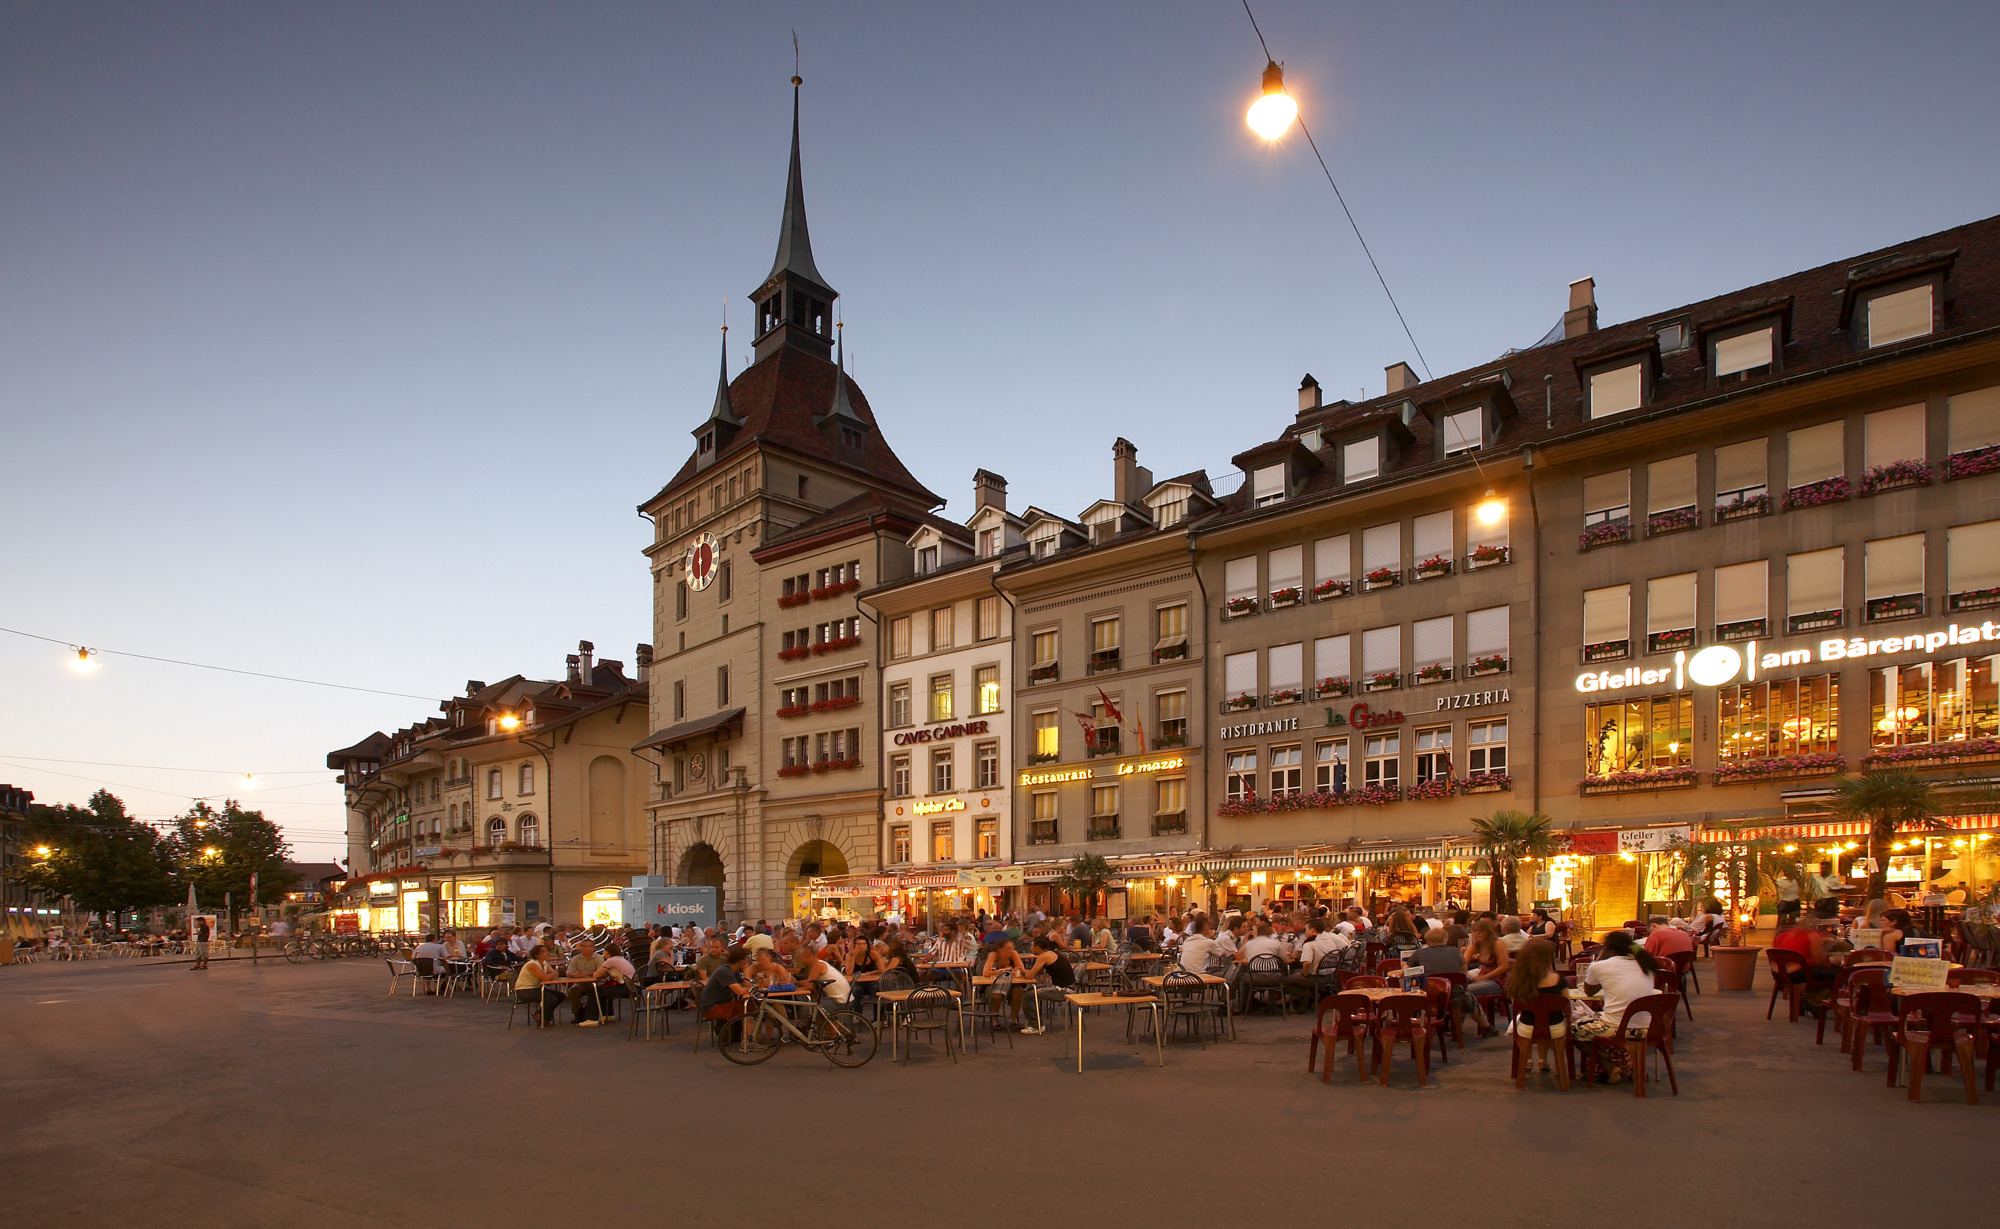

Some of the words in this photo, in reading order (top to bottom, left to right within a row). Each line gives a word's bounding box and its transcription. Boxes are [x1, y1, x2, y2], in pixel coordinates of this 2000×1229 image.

[1576, 666, 1672, 692] Gfeller
[1761, 649, 1812, 669] am
[1220, 717, 1298, 739] RISTORANTE
[1325, 707, 1345, 727] la
[1350, 703, 1405, 729] Gioia
[1437, 688, 1510, 710] PIZZERIA
[894, 729, 932, 746] CAVES
[932, 720, 989, 740] GARNIER
[1021, 769, 1093, 786] Restaurant
[1117, 763, 1134, 776] Le
[1137, 757, 1184, 773] mazot
[912, 800, 944, 816] Mister
[945, 798, 967, 811] Chu
[1621, 831, 1655, 841] Gfeller
[657, 904, 666, 914] k
[667, 903, 705, 914] kiosk
